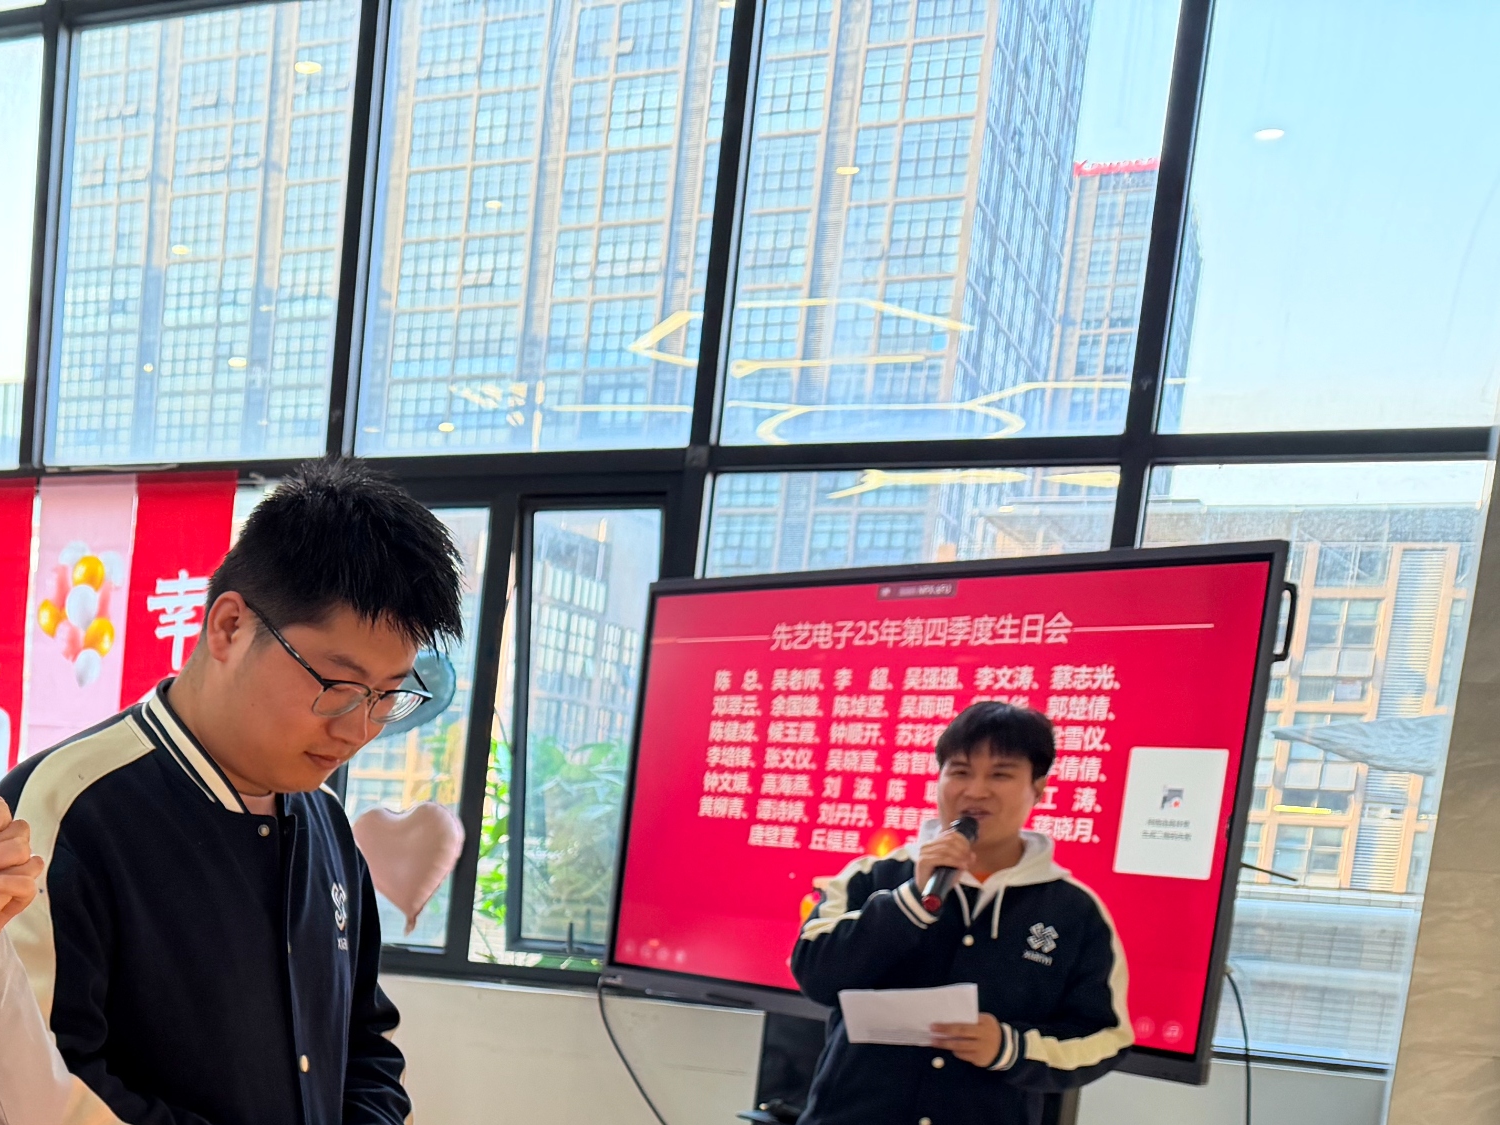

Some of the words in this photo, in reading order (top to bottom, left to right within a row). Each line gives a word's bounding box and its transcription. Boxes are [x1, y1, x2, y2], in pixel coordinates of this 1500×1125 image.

[770, 611, 1073, 650] 先艺电子25年第四季度生日会
